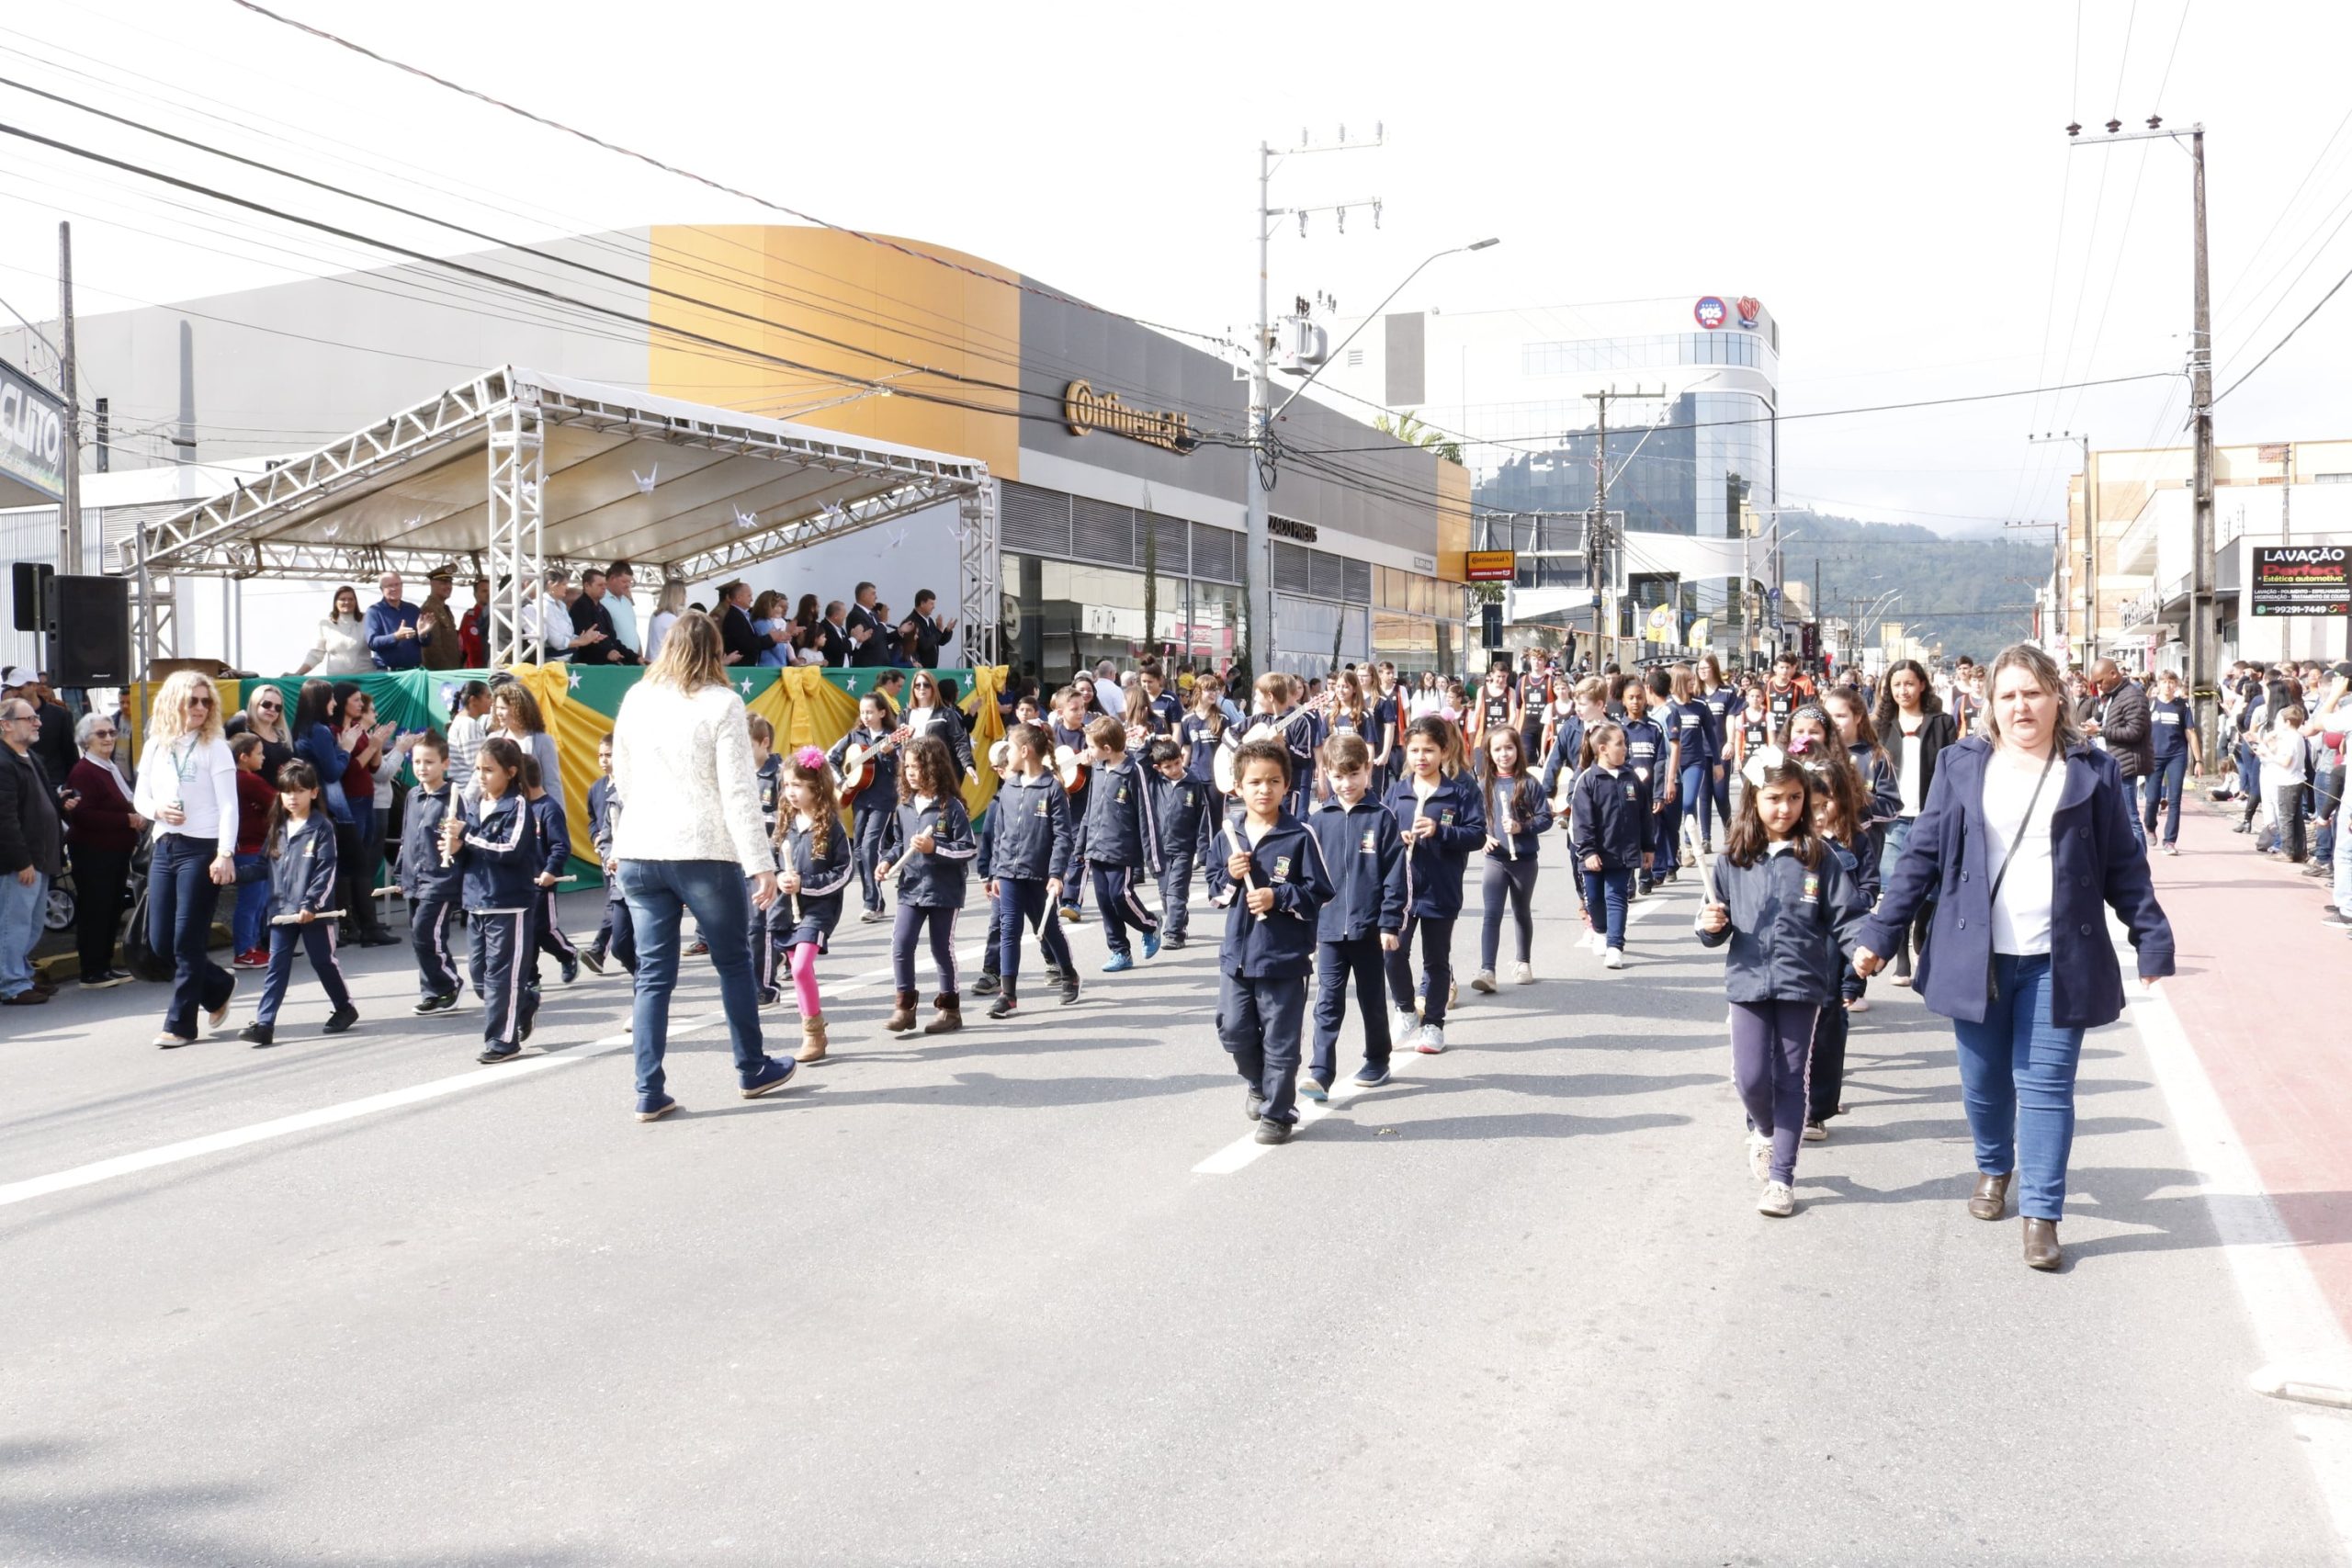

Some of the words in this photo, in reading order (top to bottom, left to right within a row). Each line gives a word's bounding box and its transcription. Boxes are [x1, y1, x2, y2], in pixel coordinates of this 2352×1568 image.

[1699, 307, 1723, 320] 105
[1293, 521, 1317, 543] PNEUS
[2264, 547, 2346, 564] LAVAÇÃO
[2263, 564, 2344, 576] Perfect
